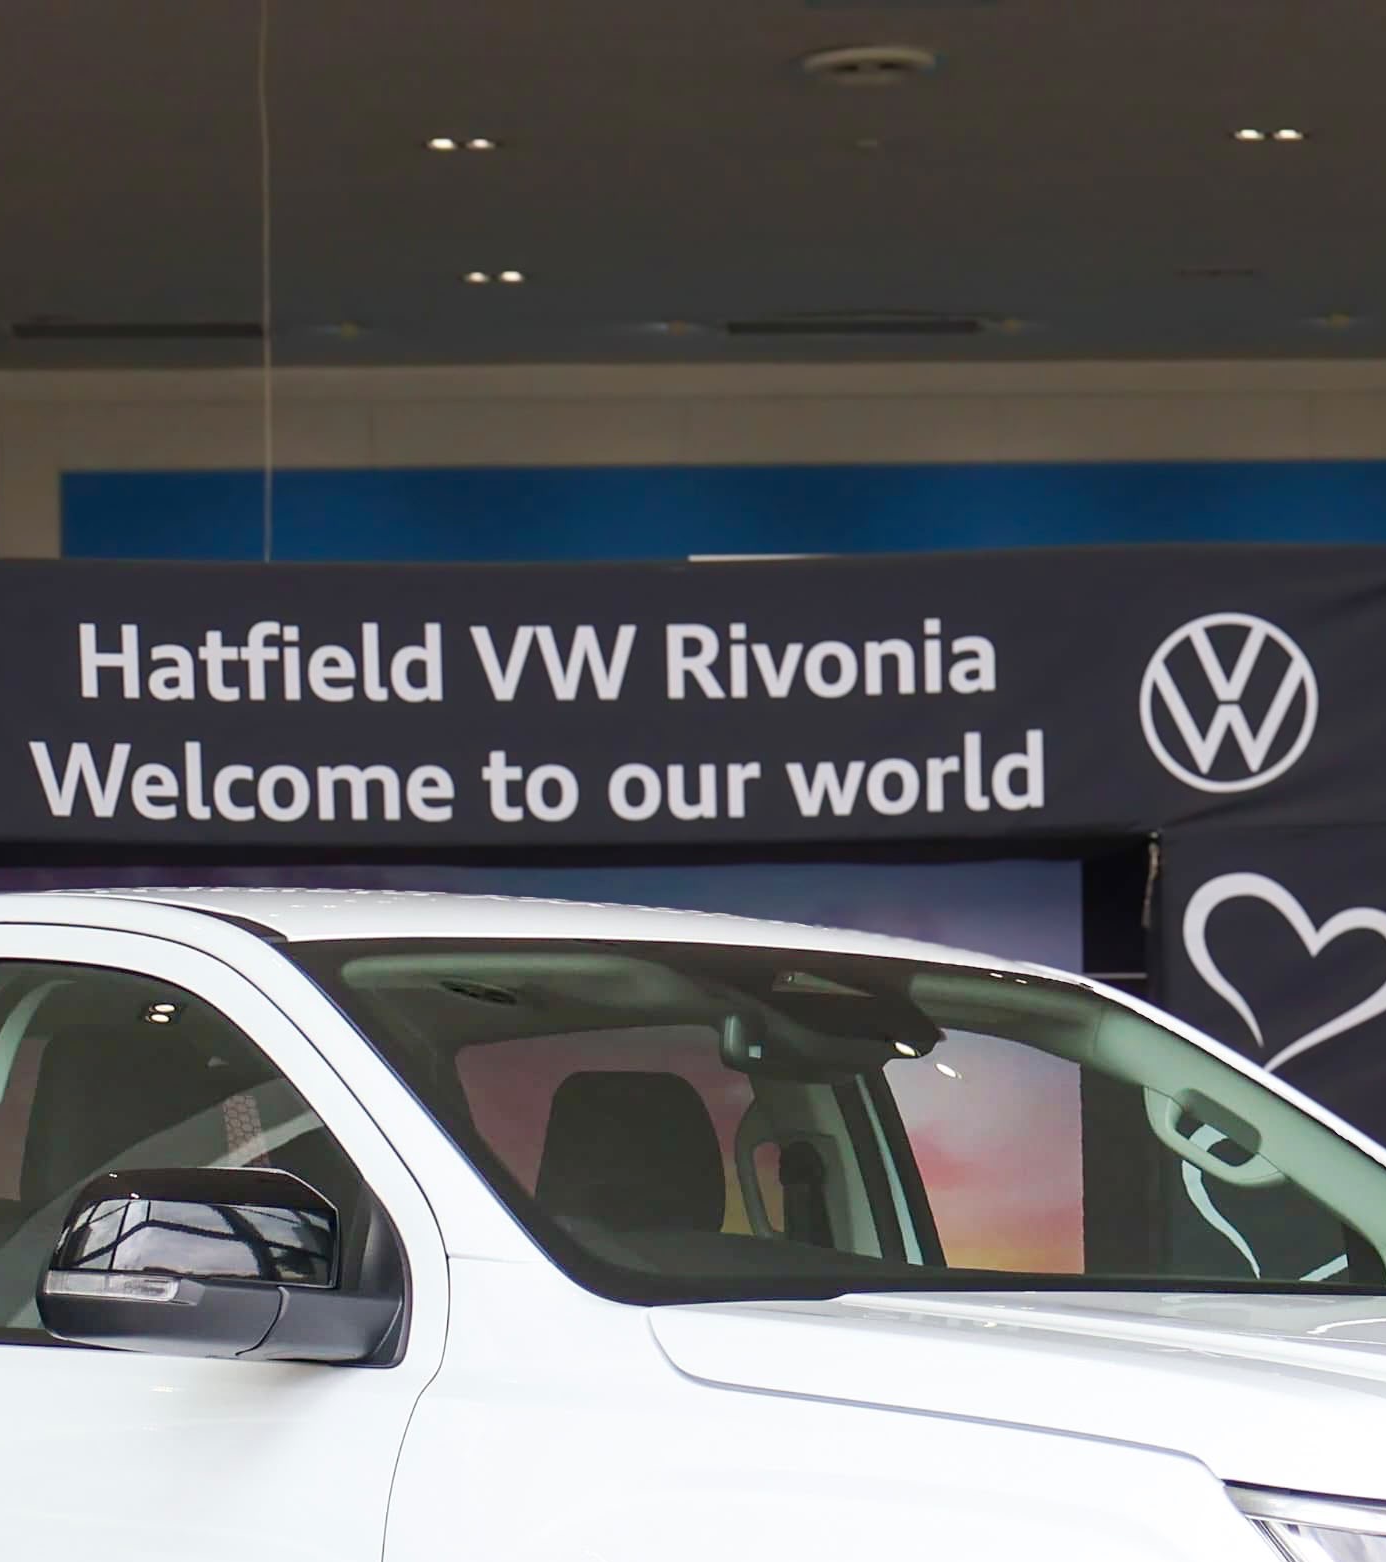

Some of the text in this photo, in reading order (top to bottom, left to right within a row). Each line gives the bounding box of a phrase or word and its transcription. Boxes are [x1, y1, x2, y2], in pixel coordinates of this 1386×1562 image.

[79, 618, 997, 702] Hatfield VW Rivonia
[29, 729, 1045, 823] Welcome to our world
